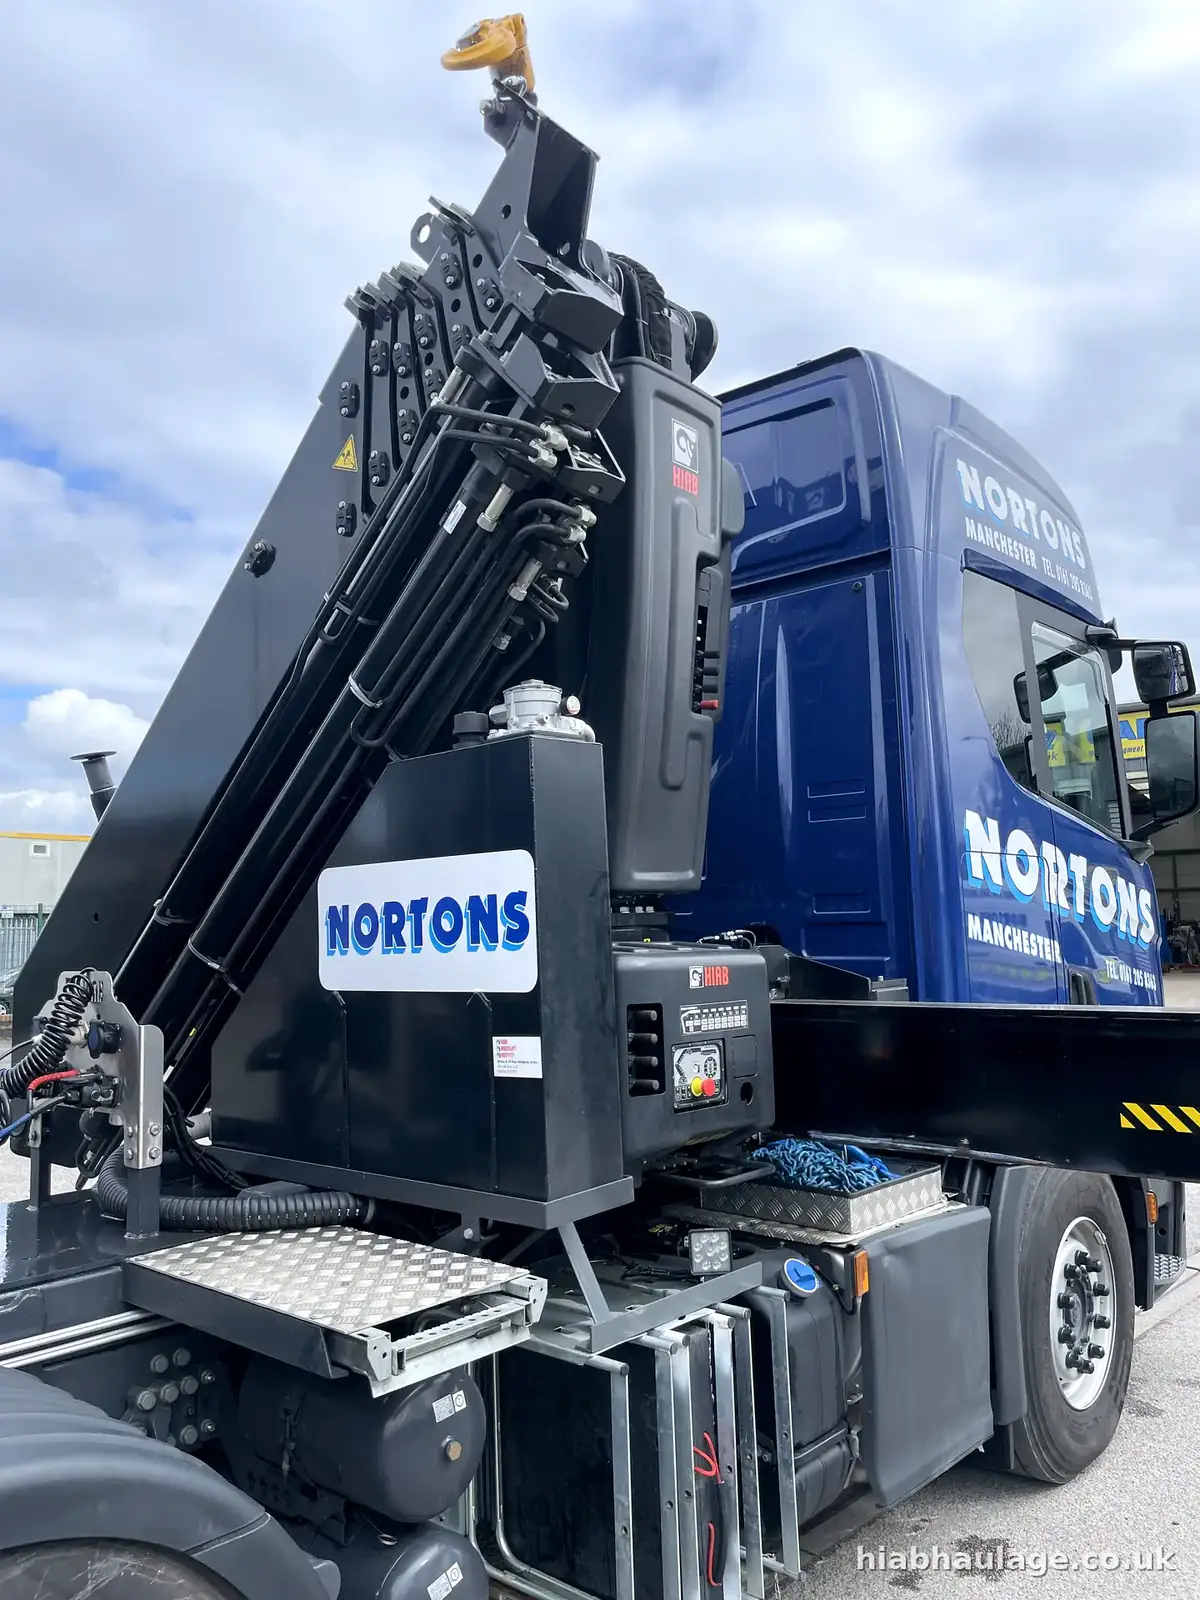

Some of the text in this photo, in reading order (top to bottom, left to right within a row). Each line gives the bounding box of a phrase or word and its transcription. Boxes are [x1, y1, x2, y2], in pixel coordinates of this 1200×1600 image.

[672, 464, 699, 496] HIAB
[956, 458, 1086, 571] NORTONS
[965, 517, 1038, 570] MANCHESTER
[1041, 556, 1056, 579] TEL.
[964, 808, 1156, 950] NORTONS
[325, 890, 530, 957] NORTONS
[967, 913, 1063, 964] MANCHESTER
[704, 966, 729, 987] HIAB
[1105, 959, 1119, 980] TEL.
